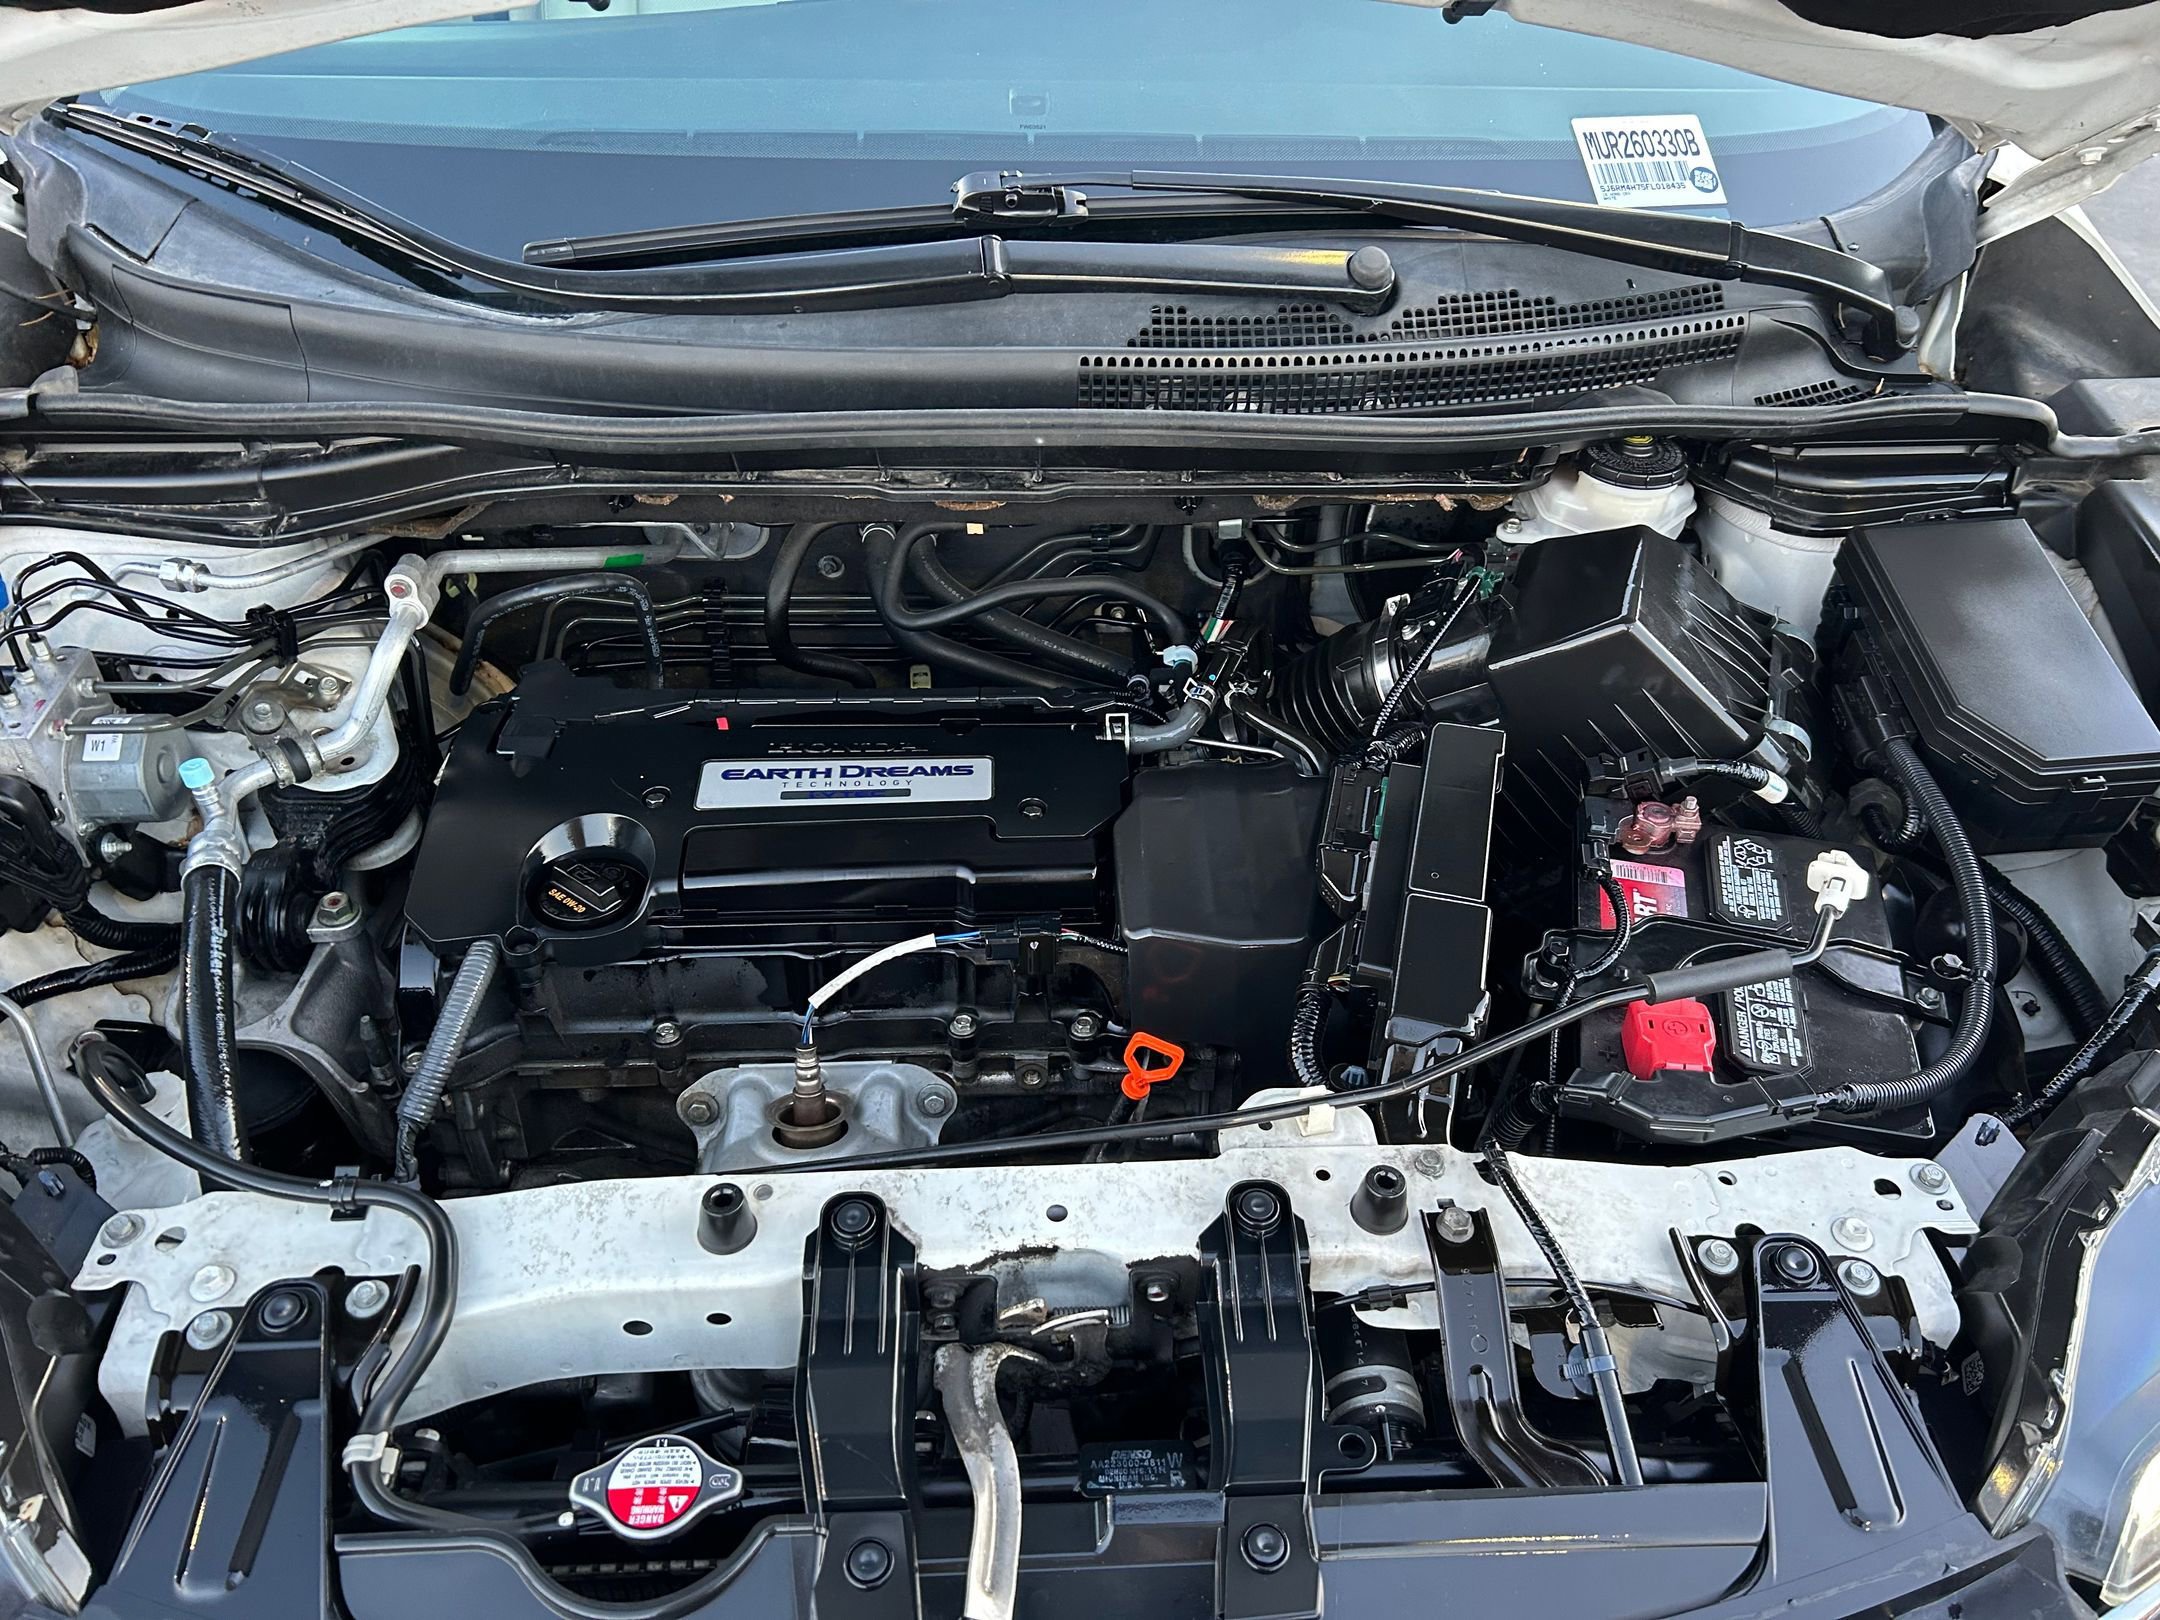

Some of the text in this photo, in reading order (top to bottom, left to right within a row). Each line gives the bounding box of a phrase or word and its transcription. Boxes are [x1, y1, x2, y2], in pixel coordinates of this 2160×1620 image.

[1583, 129, 1700, 160] MUR260330B
[91, 739, 106, 752] W1
[720, 764, 975, 781] EARTH DREAMS
[782, 779, 913, 789] TECHNOLOGY
[548, 888, 586, 913] SAE 0W-20
[1736, 1010, 1751, 1047] DANGER
[1111, 1449, 1152, 1460] DENSO
[628, 1513, 664, 1525] DANGER
